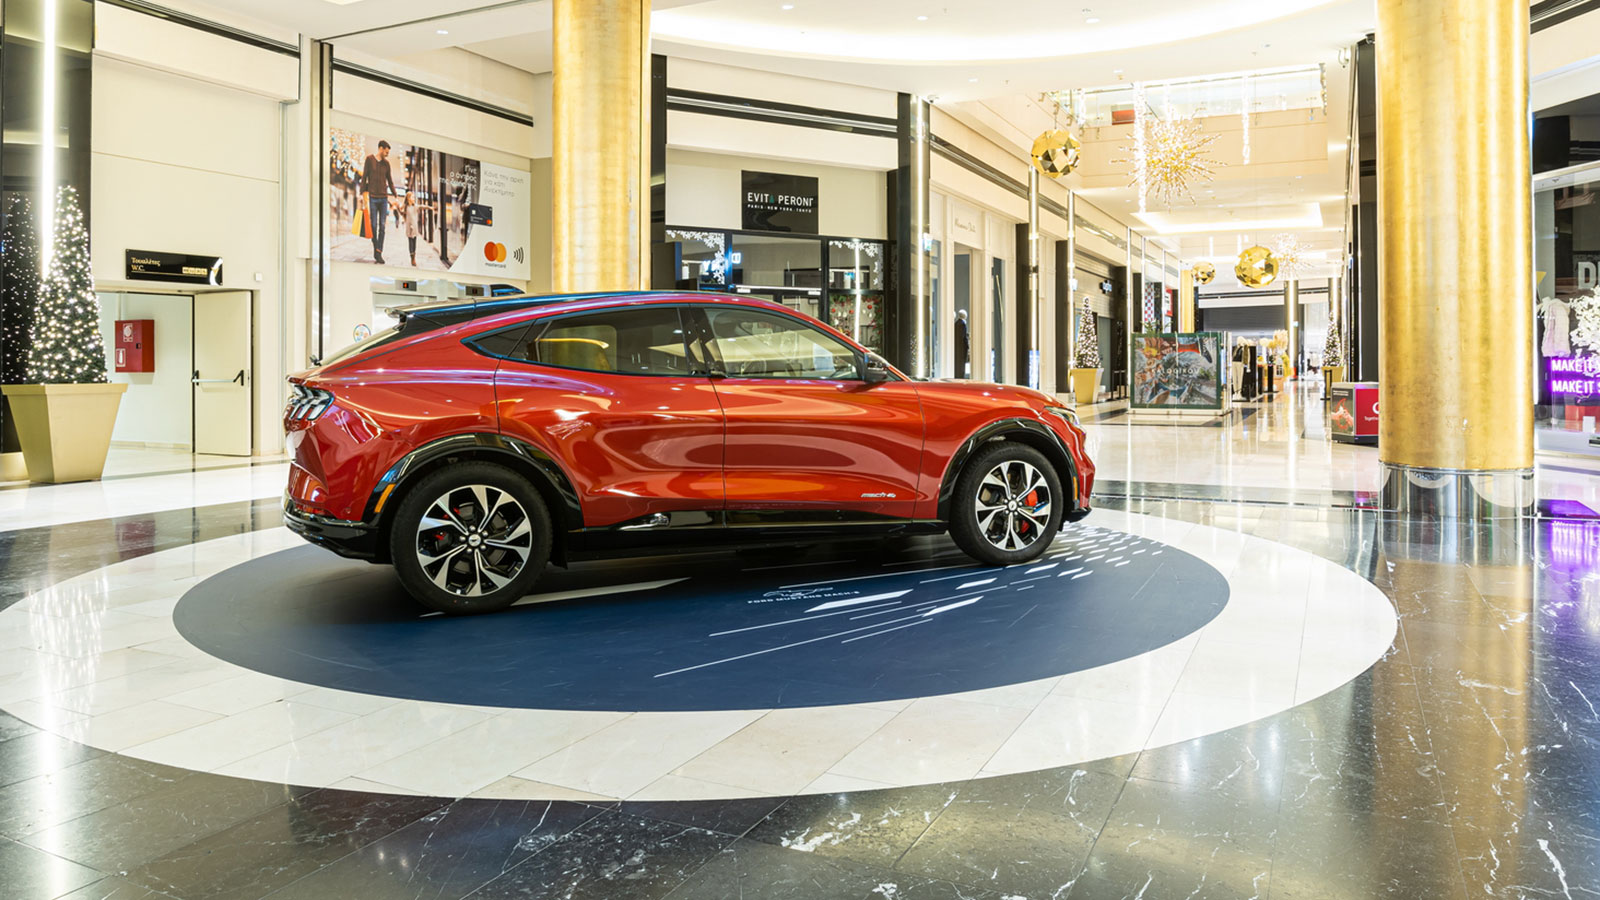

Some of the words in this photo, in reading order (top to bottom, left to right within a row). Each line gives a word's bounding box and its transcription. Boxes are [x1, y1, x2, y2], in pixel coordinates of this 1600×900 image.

[1552, 359, 1583, 372] MAKE
[1552, 380, 1583, 393] MAKE
[1584, 381, 1595, 394] IT
